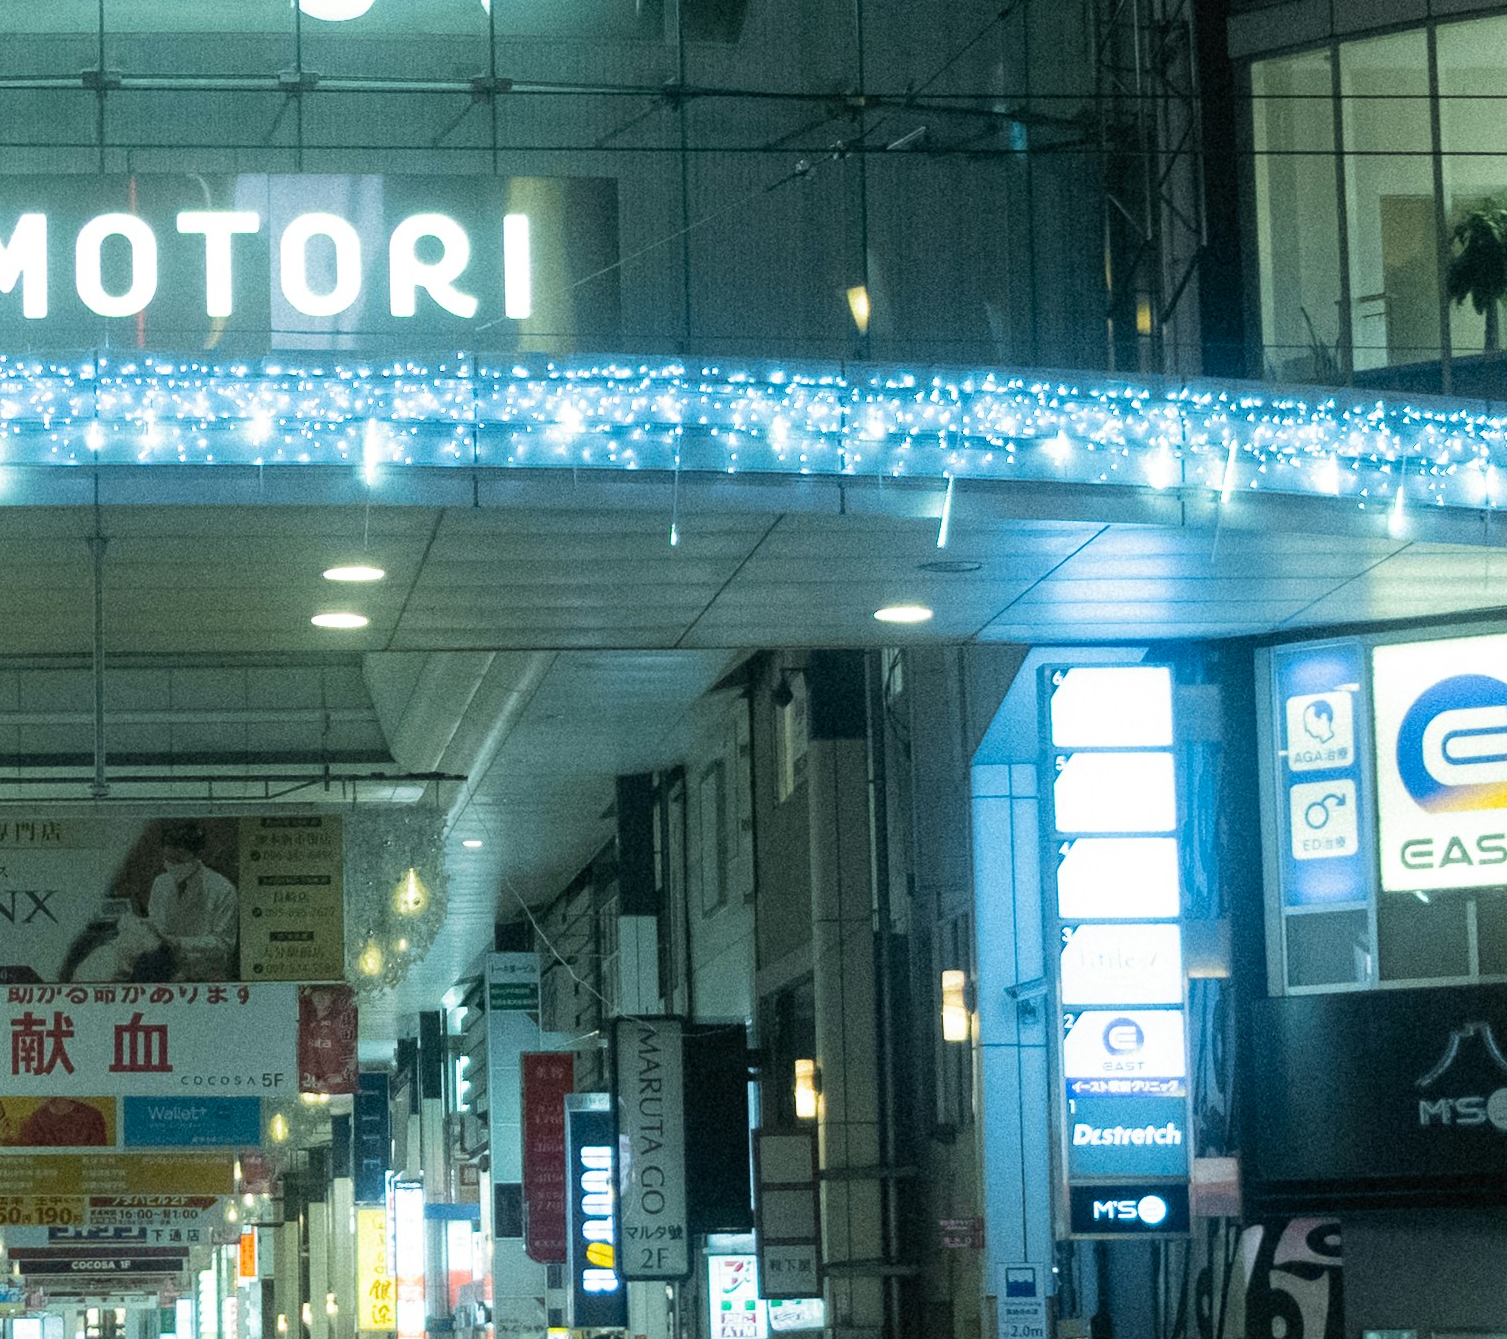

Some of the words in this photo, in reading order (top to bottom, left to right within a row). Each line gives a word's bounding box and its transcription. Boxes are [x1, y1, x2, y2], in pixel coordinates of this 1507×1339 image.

[1301, 835, 1347, 852] ED治療
[1063, 1014, 1074, 1029] 2
[9, 1011, 174, 1076] 献血
[1102, 1062, 1146, 1071] EAST
[180, 1075, 257, 1086] COCOSA
[261, 1072, 284, 1088] 5F
[1071, 1080, 1180, 1094] イースト駅前クリニック
[637, 1027, 664, 1156] MARUTA
[1073, 1122, 1182, 1147] Dr.stretch
[640, 1165, 666, 1216] GO
[151, 1229, 201, 1242] 下通店
[71, 1260, 116, 1270] COCOSA
[120, 1260, 132, 1270] 1F
[641, 1248, 670, 1269] 2F
